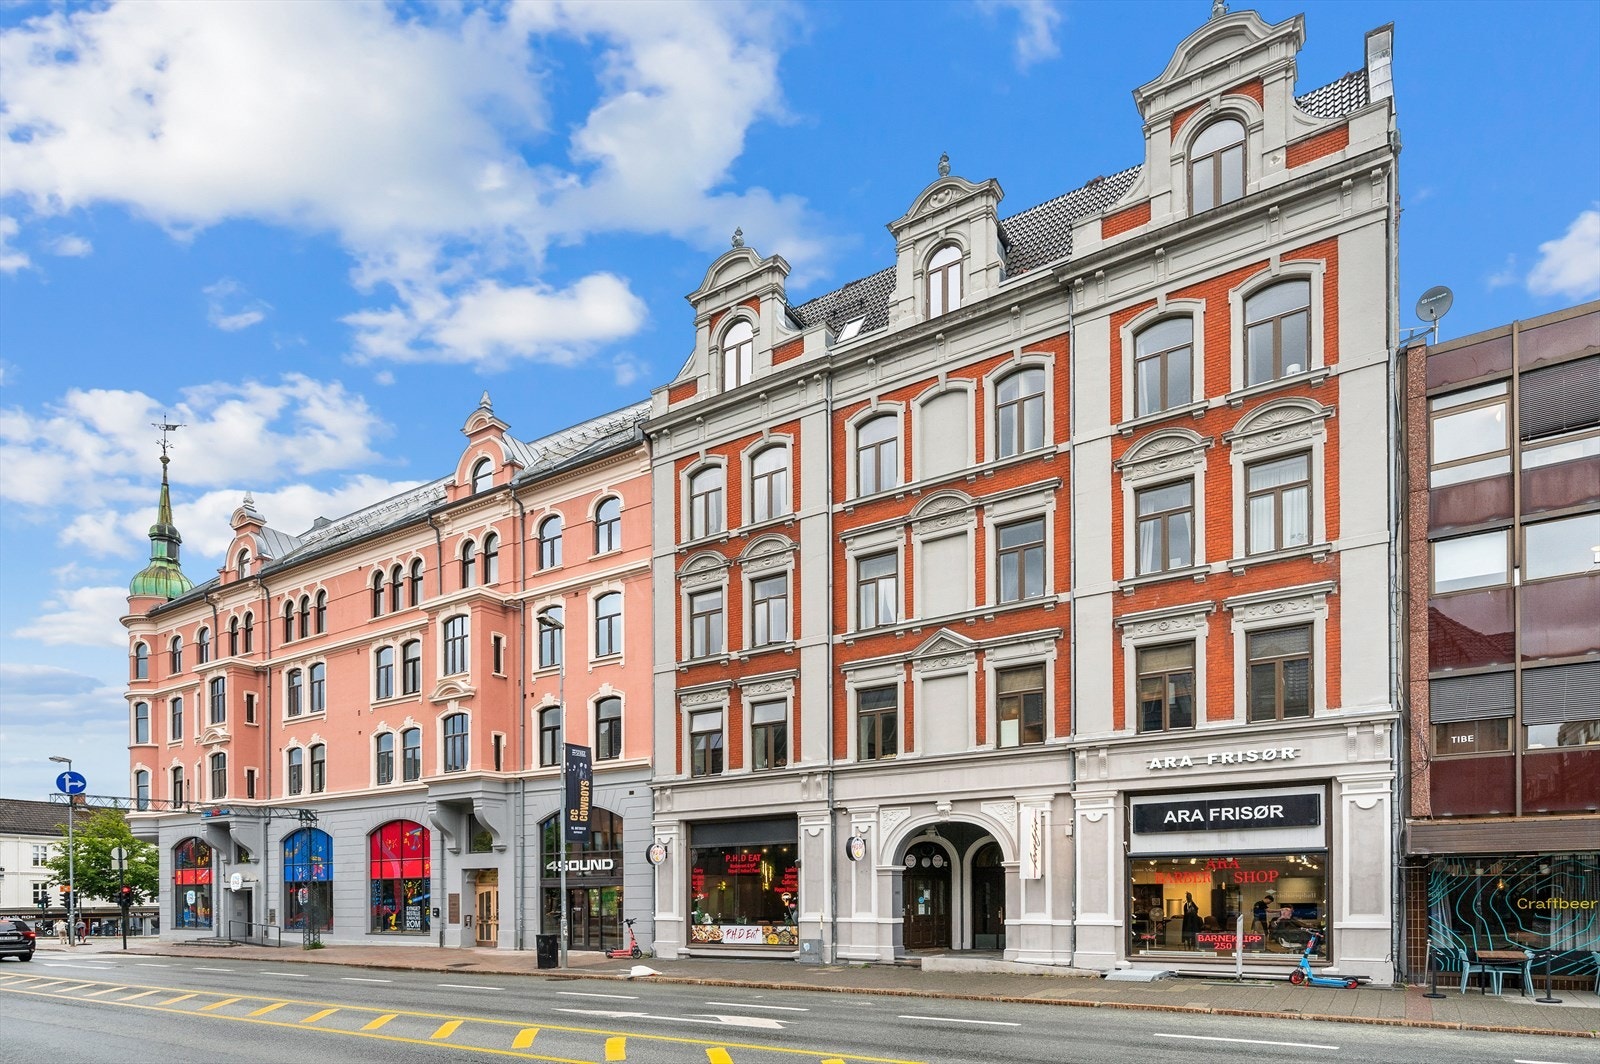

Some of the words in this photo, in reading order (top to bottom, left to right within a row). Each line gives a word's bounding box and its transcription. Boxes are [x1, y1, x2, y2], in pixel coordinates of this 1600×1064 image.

[1451, 735, 1474, 744] TIBE
[1149, 755, 1193, 770] ARA
[1207, 746, 1296, 765] FRISØR
[579, 780, 590, 821] COWBOYS
[570, 809, 579, 821] CC
[1164, 808, 1205, 824] ARA
[1209, 804, 1285, 822] FRISØR
[748, 854, 761, 862] EAT
[1205, 857, 1240, 870] ARA
[546, 858, 614, 872] 4SOUND
[1154, 871, 1212, 884] BARBER
[1234, 870, 1279, 884] SHOP
[1517, 898, 1599, 909] Craftbeer
[1197, 934, 1262, 943] BARNEKIPP
